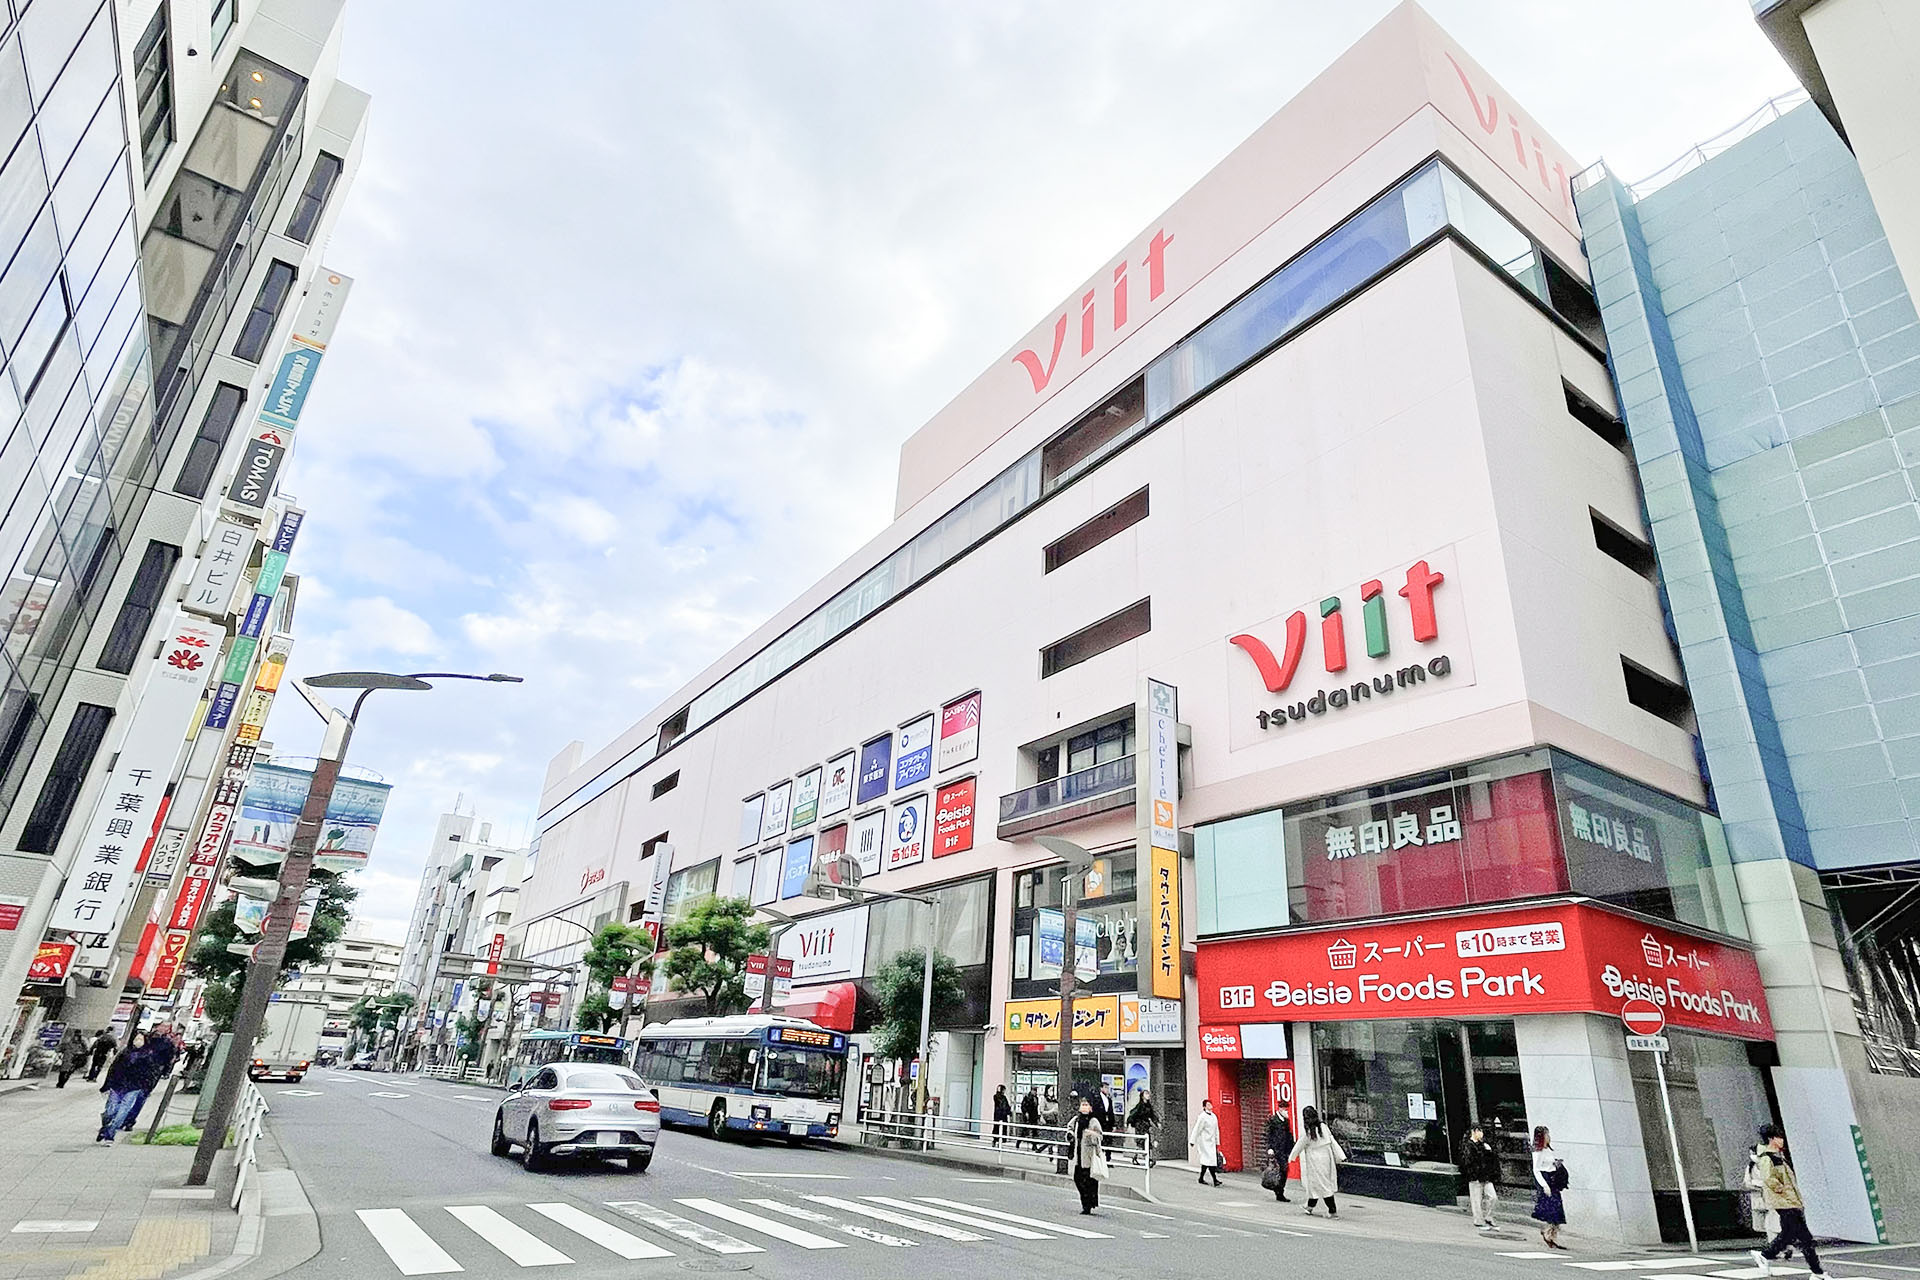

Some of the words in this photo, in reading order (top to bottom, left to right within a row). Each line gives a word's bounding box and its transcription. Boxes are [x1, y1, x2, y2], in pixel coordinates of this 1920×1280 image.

[240, 446, 275, 501] TOMAS
[197, 530, 242, 605] 白井ビル
[1229, 560, 1445, 693] Viit
[1256, 655, 1452, 730] tsudanuma
[936, 804, 971, 825] Beisia
[938, 824, 956, 834] Foods
[956, 819, 970, 829] Park
[74, 769, 152, 921] 千葉興業銀行
[202, 812, 227, 853] カラオケ
[945, 835, 959, 848] B1F
[1325, 805, 1462, 861] 無印良品
[1569, 801, 1653, 863] 無印良品
[196, 854, 214, 863] 2F
[1159, 867, 1174, 976] タウンハウジング
[159, 935, 186, 967] DVD
[800, 927, 835, 958] Viit
[1363, 936, 1446, 964] スーパー
[1460, 928, 1561, 953] 夜10時まで営業
[1663, 945, 1710, 970] スーパー
[1222, 987, 1254, 1007] B1F
[1264, 980, 1352, 1007] Beisia
[1359, 973, 1455, 1003] Foods
[1459, 967, 1547, 998] Park
[1601, 964, 1666, 1006] Beisia
[1666, 978, 1723, 1017] Foods
[1721, 990, 1762, 1024] Park
[1025, 1009, 1111, 1028] タウンジング
[1202, 1033, 1236, 1045] Beisia
